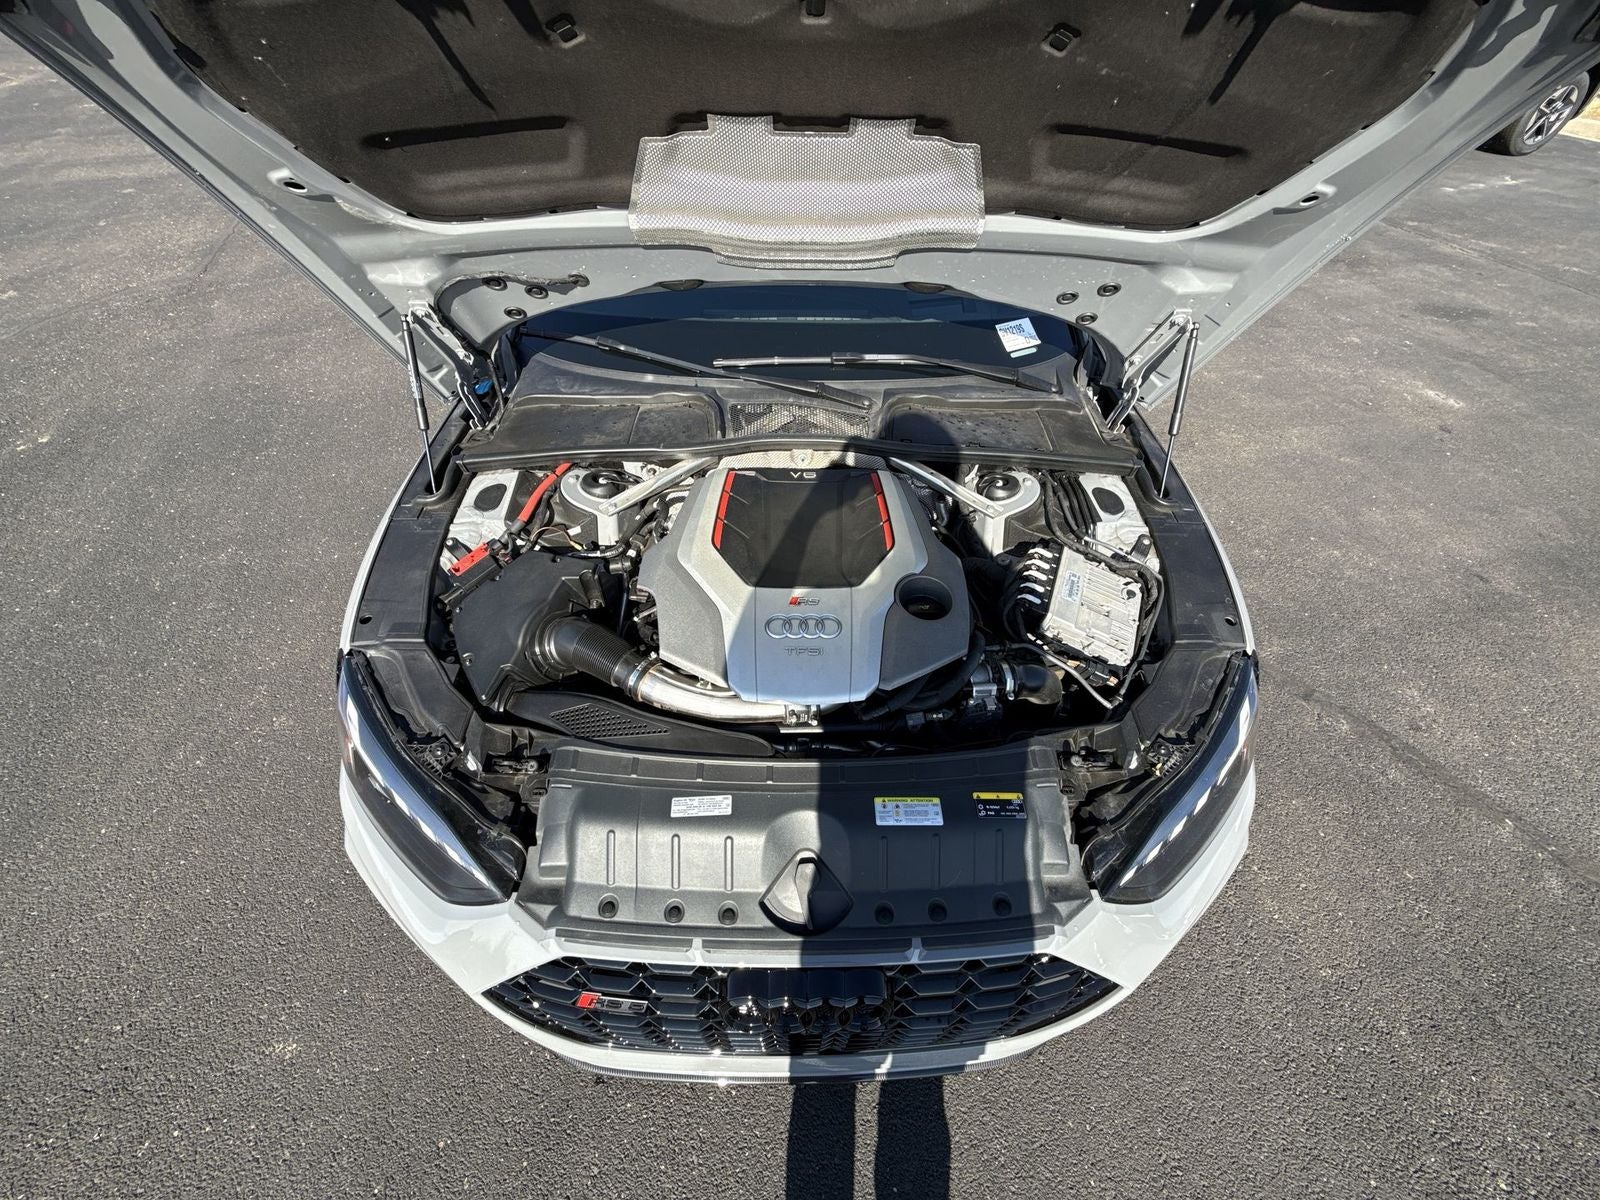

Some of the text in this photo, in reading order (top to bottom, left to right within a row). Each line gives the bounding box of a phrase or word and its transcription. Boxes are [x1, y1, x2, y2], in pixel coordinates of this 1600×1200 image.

[789, 471, 817, 479] V6
[792, 596, 820, 606] RS
[784, 646, 825, 657] TFSI
